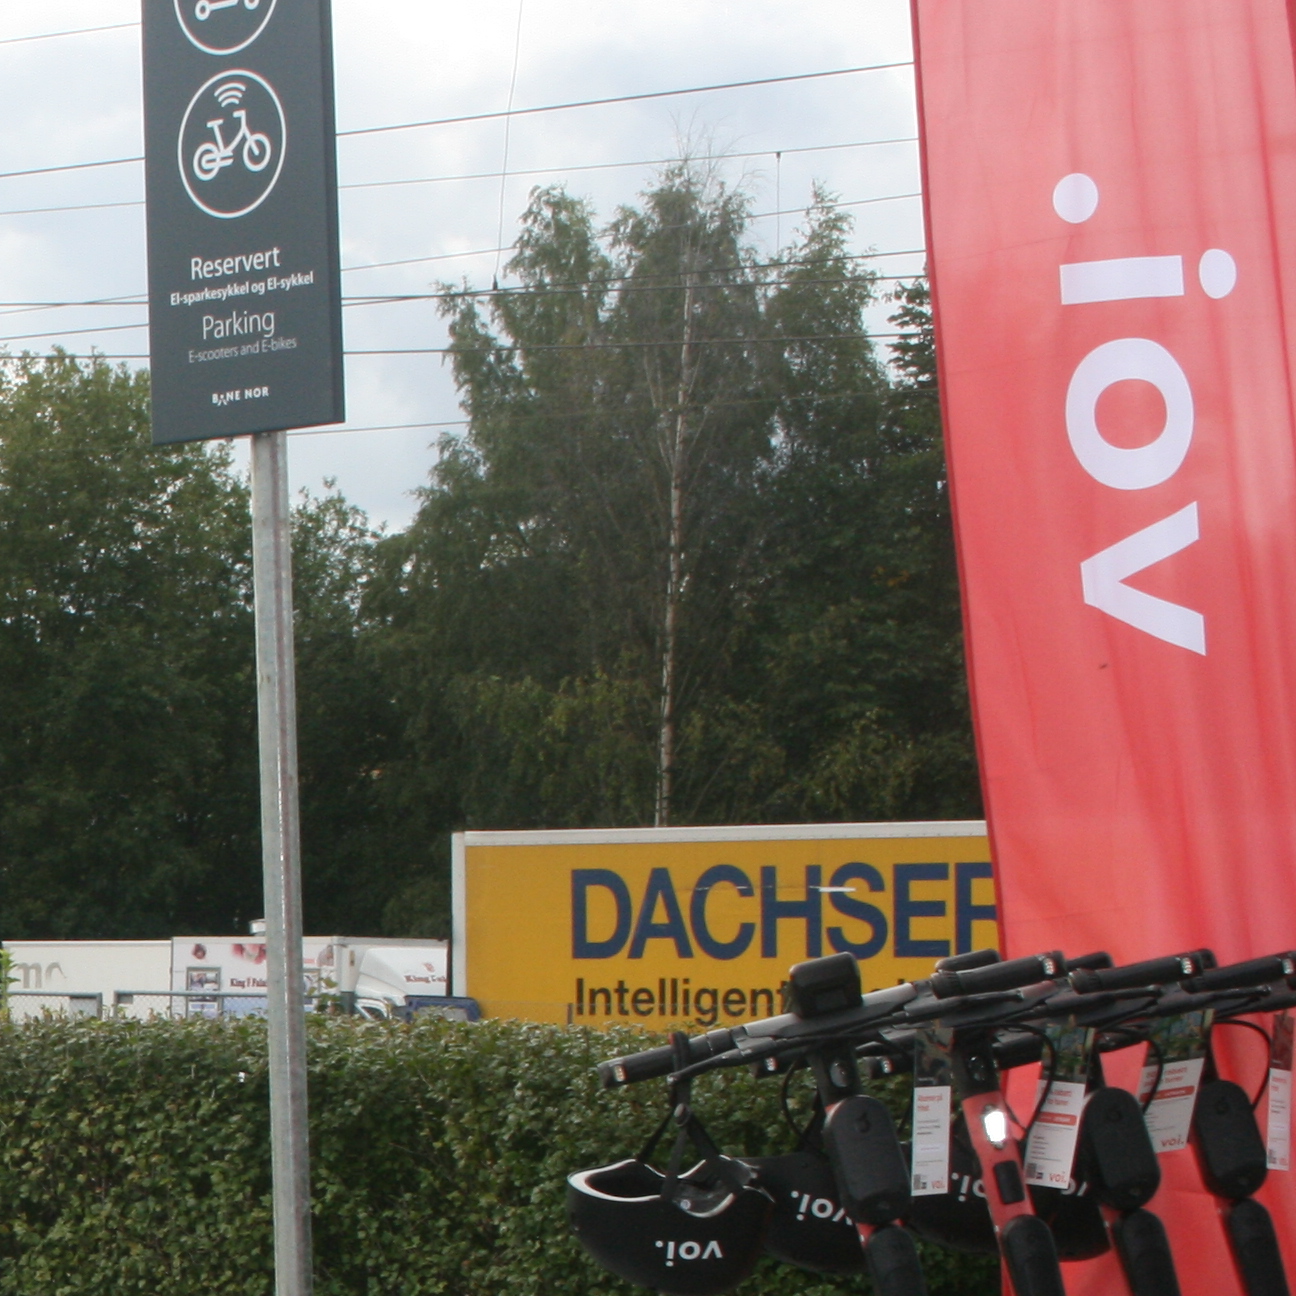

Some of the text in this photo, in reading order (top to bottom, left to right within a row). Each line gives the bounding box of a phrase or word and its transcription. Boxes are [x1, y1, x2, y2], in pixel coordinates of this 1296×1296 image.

[190, 247, 281, 281] Reservert
[170, 270, 314, 306] El-sparkesykkel og El-sykkel
[202, 310, 276, 340] Parking
[188, 336, 297, 363] E-scooters and E-bikes
[244, 385, 270, 400] NOR
[1052, 172, 1237, 656] voi.
[790, 1190, 854, 1227] voi.
[655, 1240, 724, 1267] voi.
